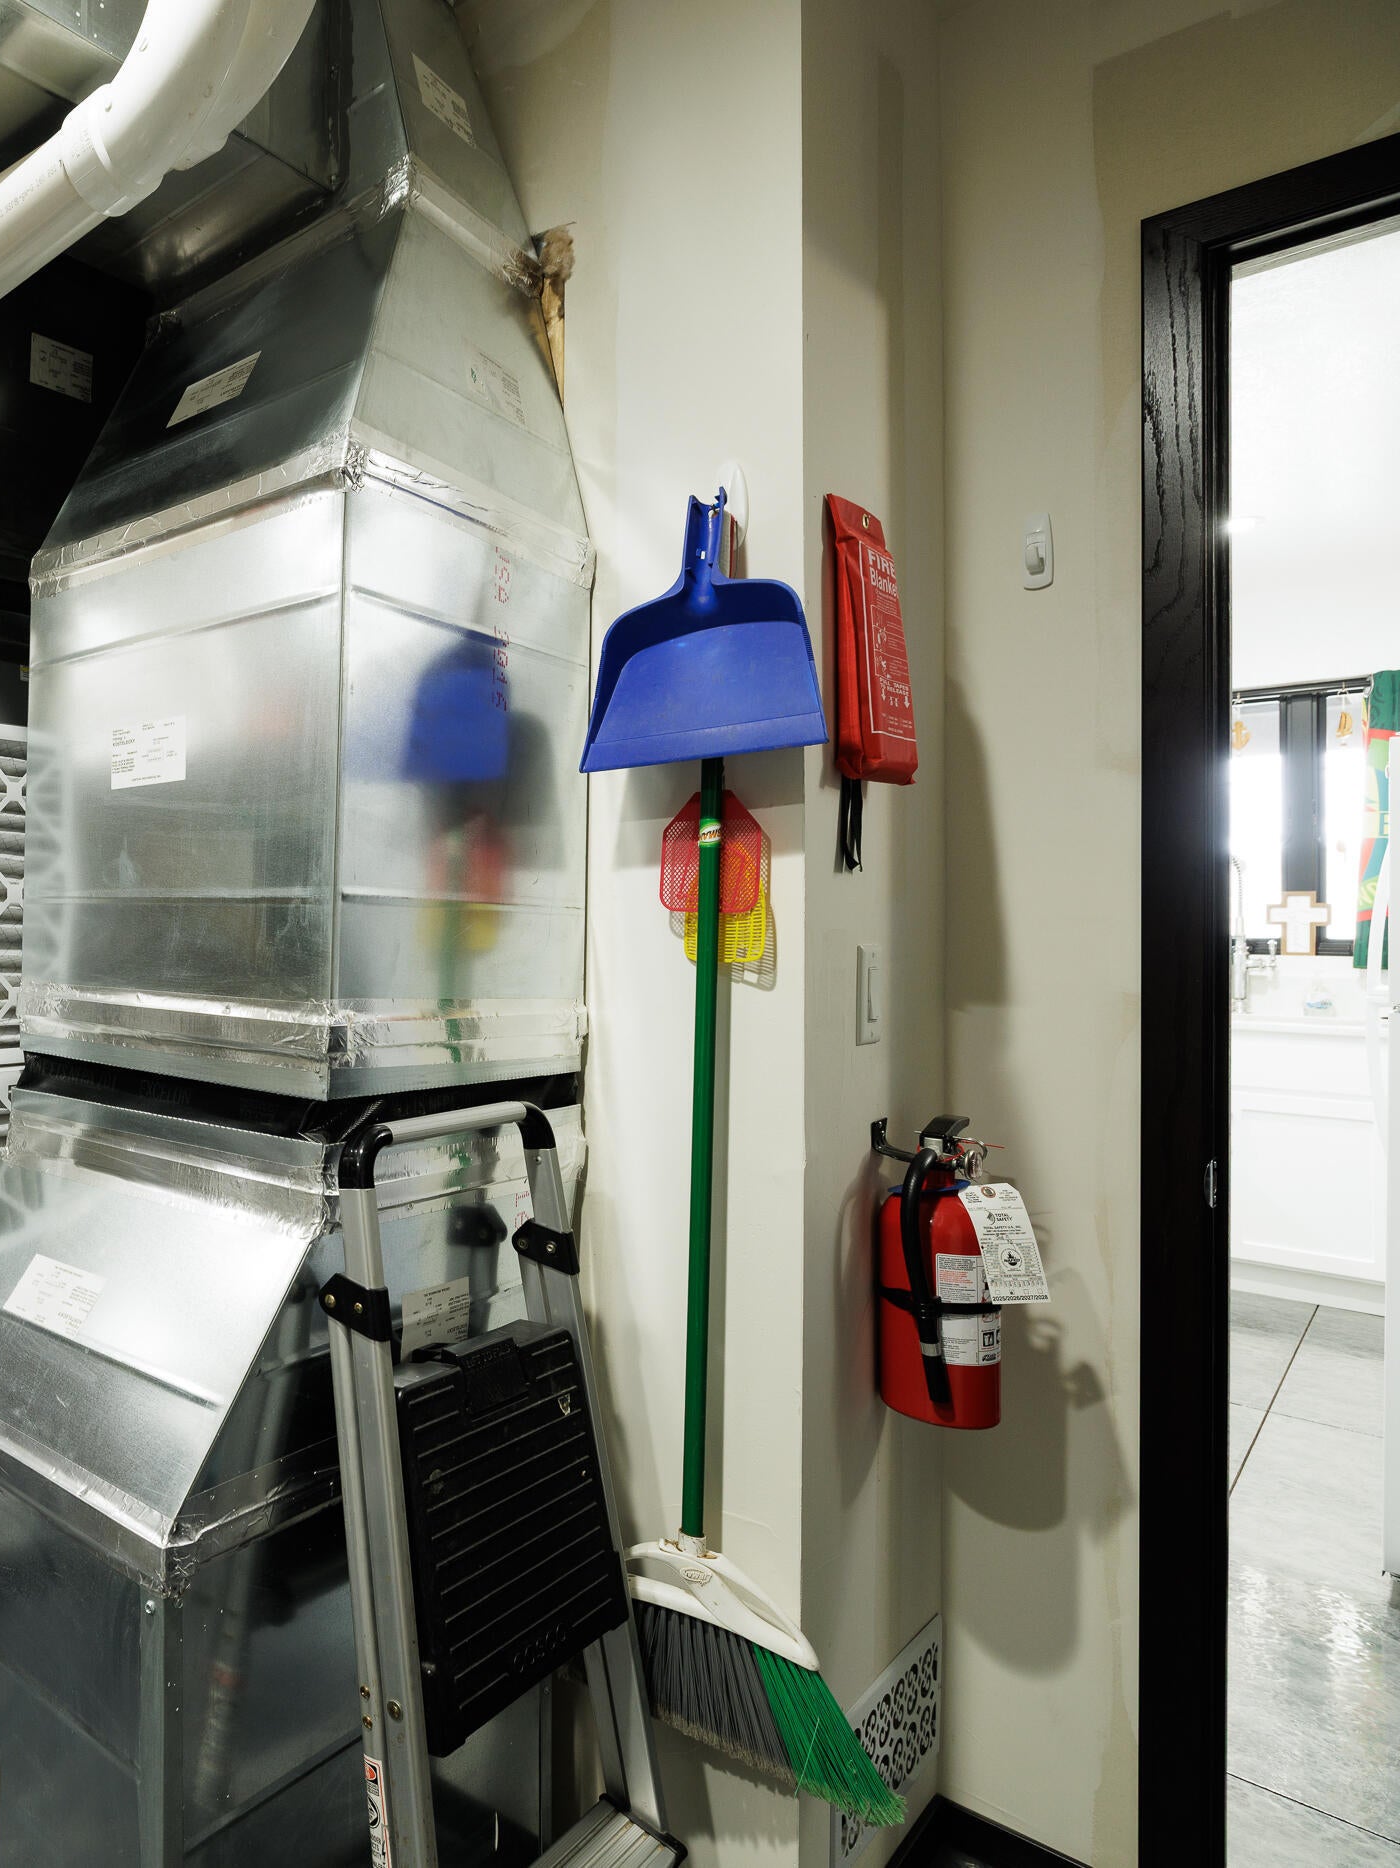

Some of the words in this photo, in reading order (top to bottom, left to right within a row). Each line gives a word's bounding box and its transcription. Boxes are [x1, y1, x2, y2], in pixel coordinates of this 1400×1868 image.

[868, 548, 897, 579] FIRE
[869, 567, 898, 597] Blanke
[886, 686, 909, 696] RELEASE
